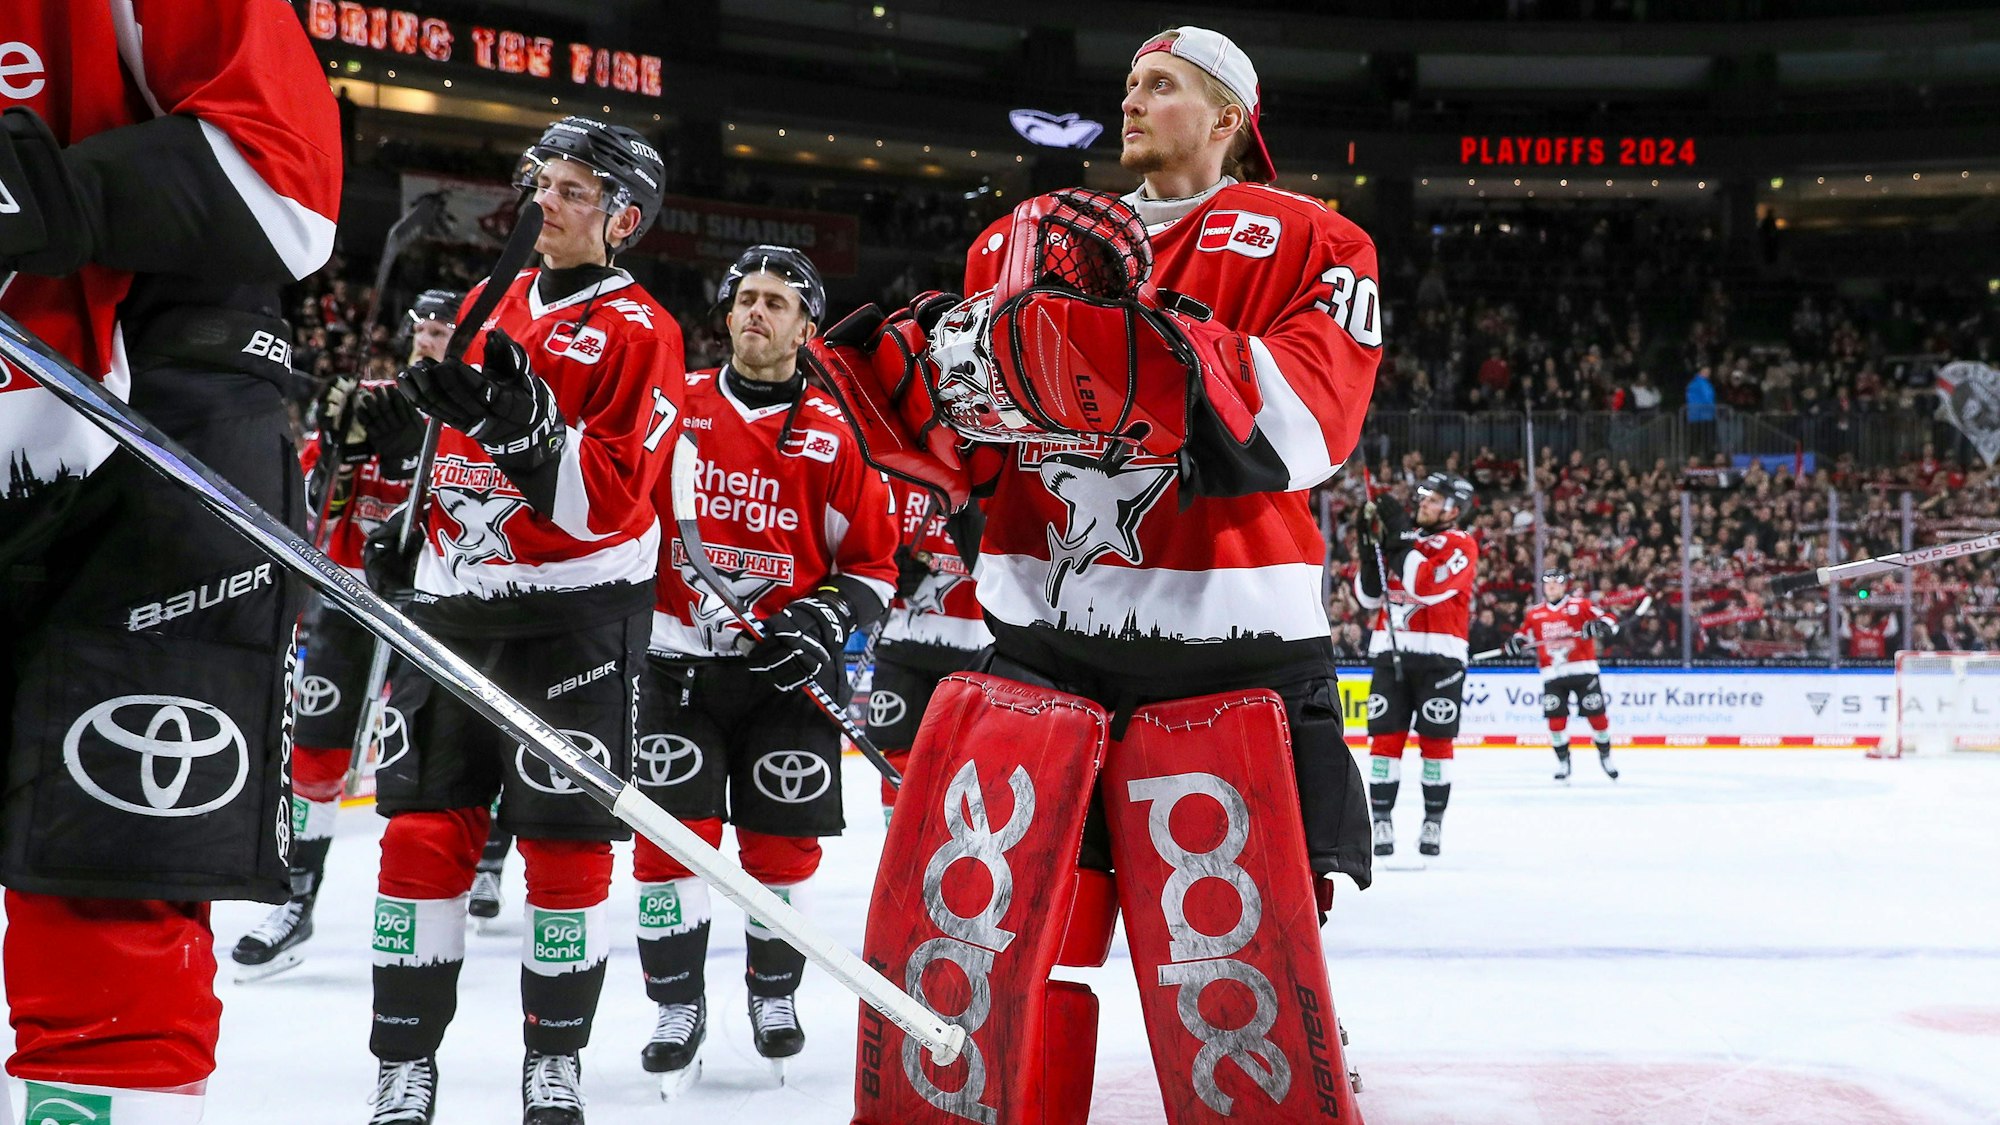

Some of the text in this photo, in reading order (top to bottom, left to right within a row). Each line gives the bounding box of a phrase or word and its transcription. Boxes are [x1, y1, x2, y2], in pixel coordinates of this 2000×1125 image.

[1461, 137, 1696, 165] PLAYOFFS 2024
[661, 208, 817, 247] UN SHARKS
[1243, 222, 1269, 236] 30
[1313, 265, 1384, 348] 30
[694, 491, 799, 533] nergie
[743, 554, 792, 582] HAIE
[125, 562, 273, 632] BAUER
[546, 660, 618, 700] BAUER
[1621, 691, 1657, 706] zur
[1665, 687, 1764, 706] Karriere
[1842, 695, 1991, 714] STAHL
[640, 911, 679, 925] Bank
[535, 942, 581, 959] Bank
